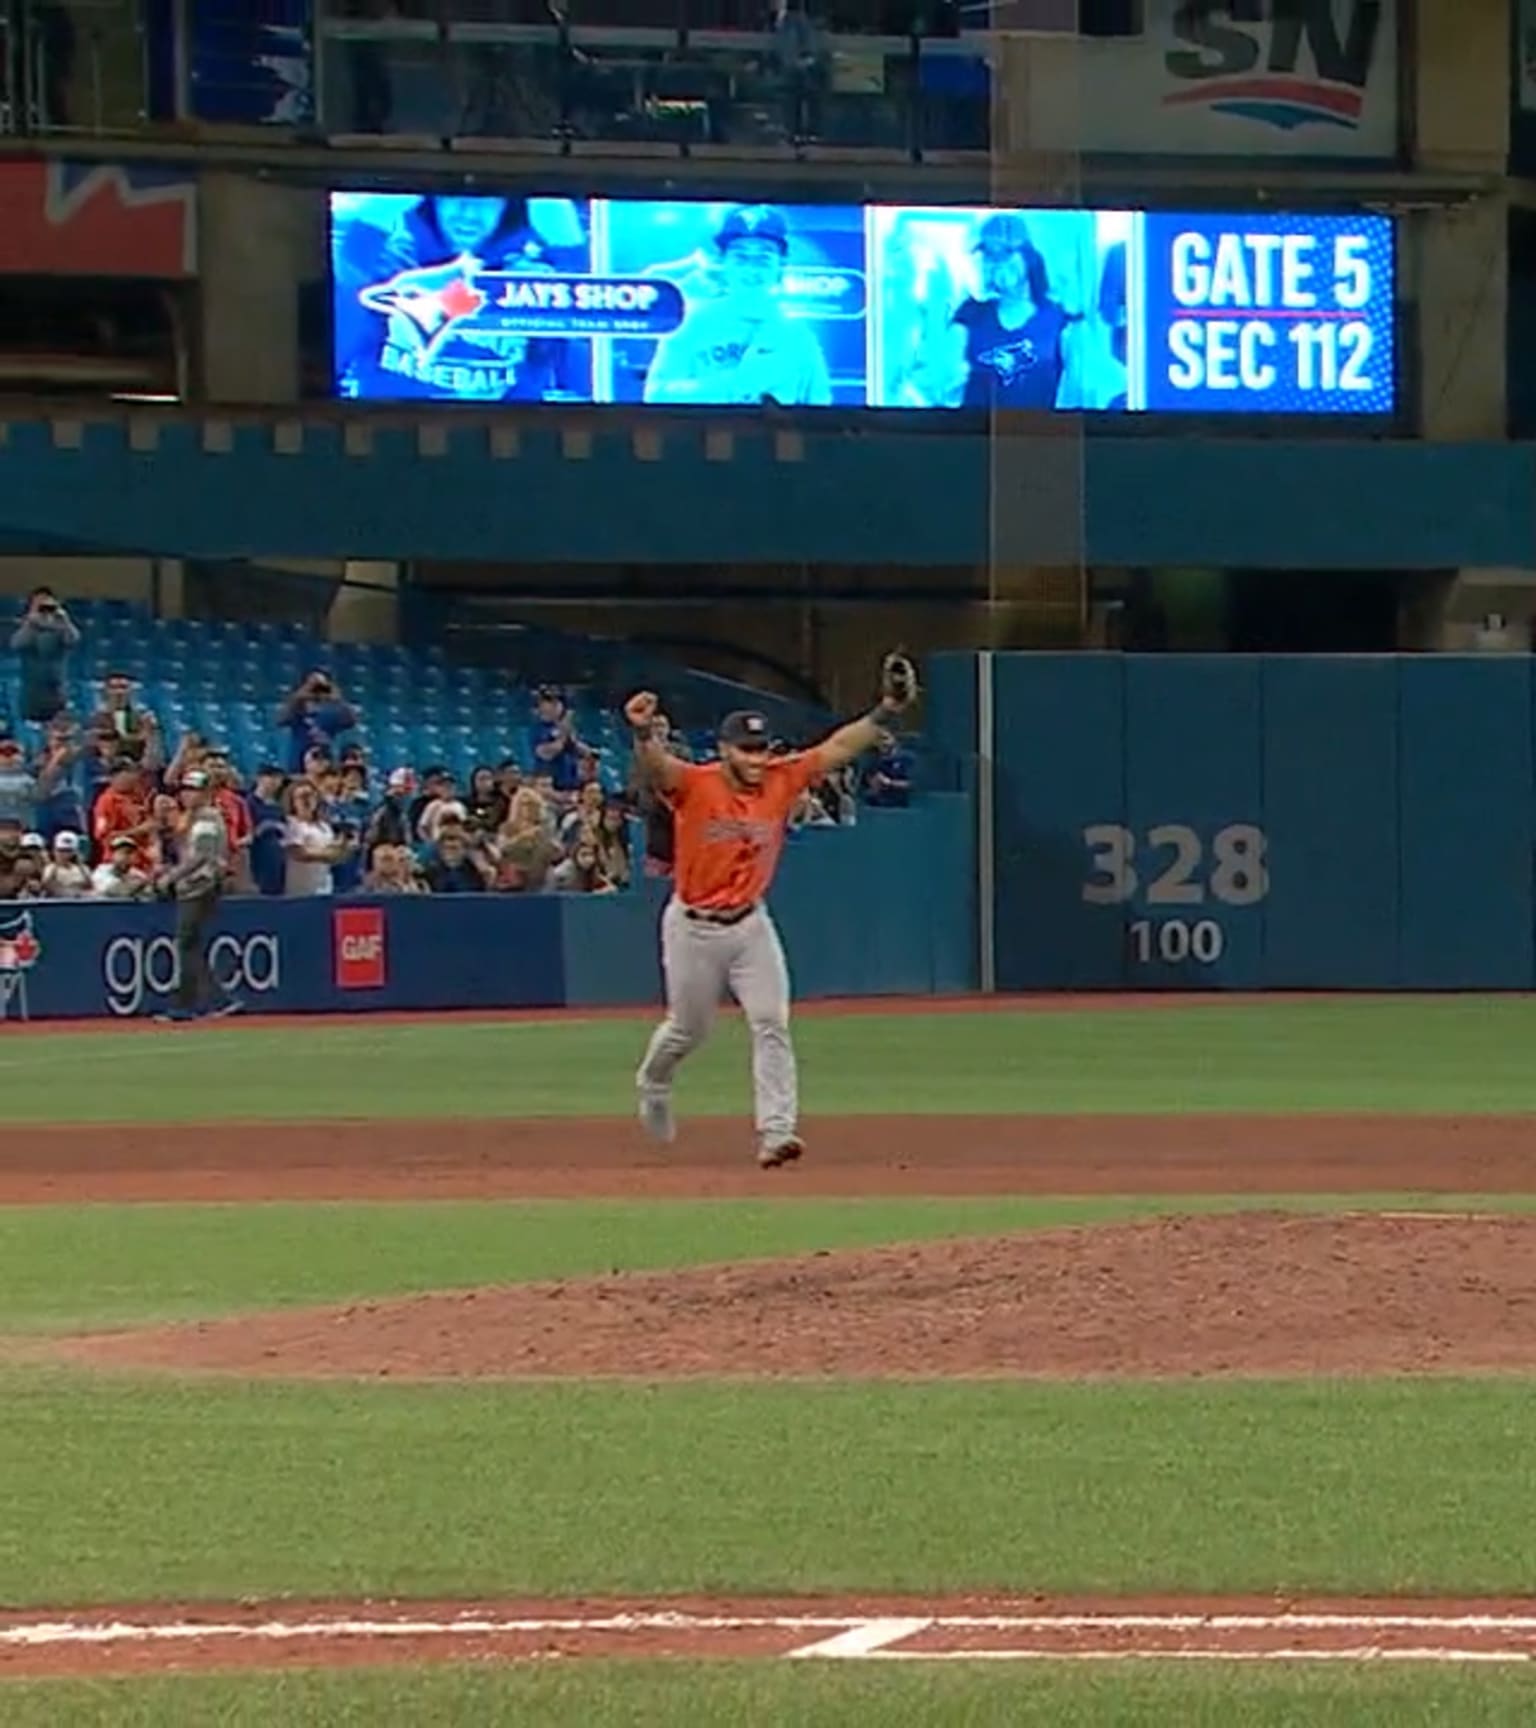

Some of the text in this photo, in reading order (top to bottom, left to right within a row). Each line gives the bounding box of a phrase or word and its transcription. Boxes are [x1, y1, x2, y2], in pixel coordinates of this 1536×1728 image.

[1165, 0, 1379, 87] SN
[574, 283, 659, 311] SHOP
[1171, 232, 1371, 308] GATE 5
[1167, 320, 1373, 390] SEC 112
[1082, 823, 1269, 904] 328
[341, 935, 382, 961] GAF
[1129, 919, 1222, 962] 100
